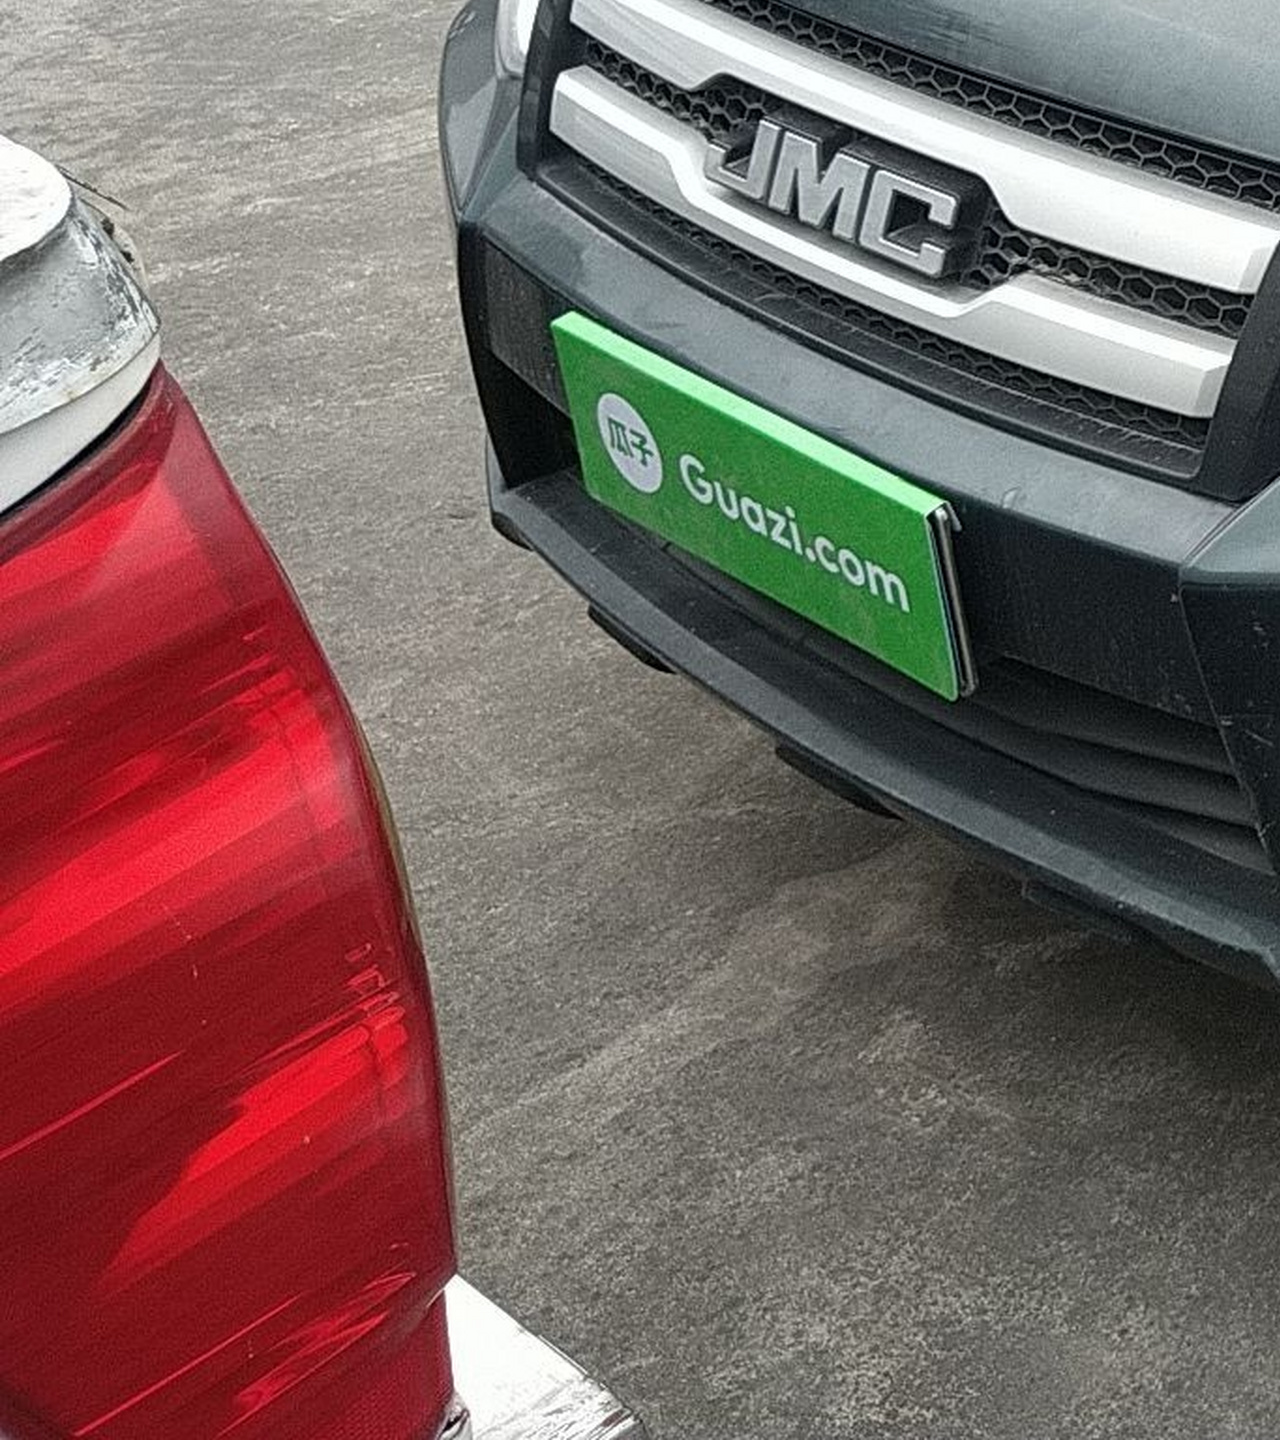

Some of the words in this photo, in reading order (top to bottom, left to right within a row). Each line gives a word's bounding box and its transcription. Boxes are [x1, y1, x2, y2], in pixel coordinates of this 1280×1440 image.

[704, 119, 960, 277] JMC
[606, 415, 656, 470] 瓜子
[678, 454, 911, 615] Guazi.com
